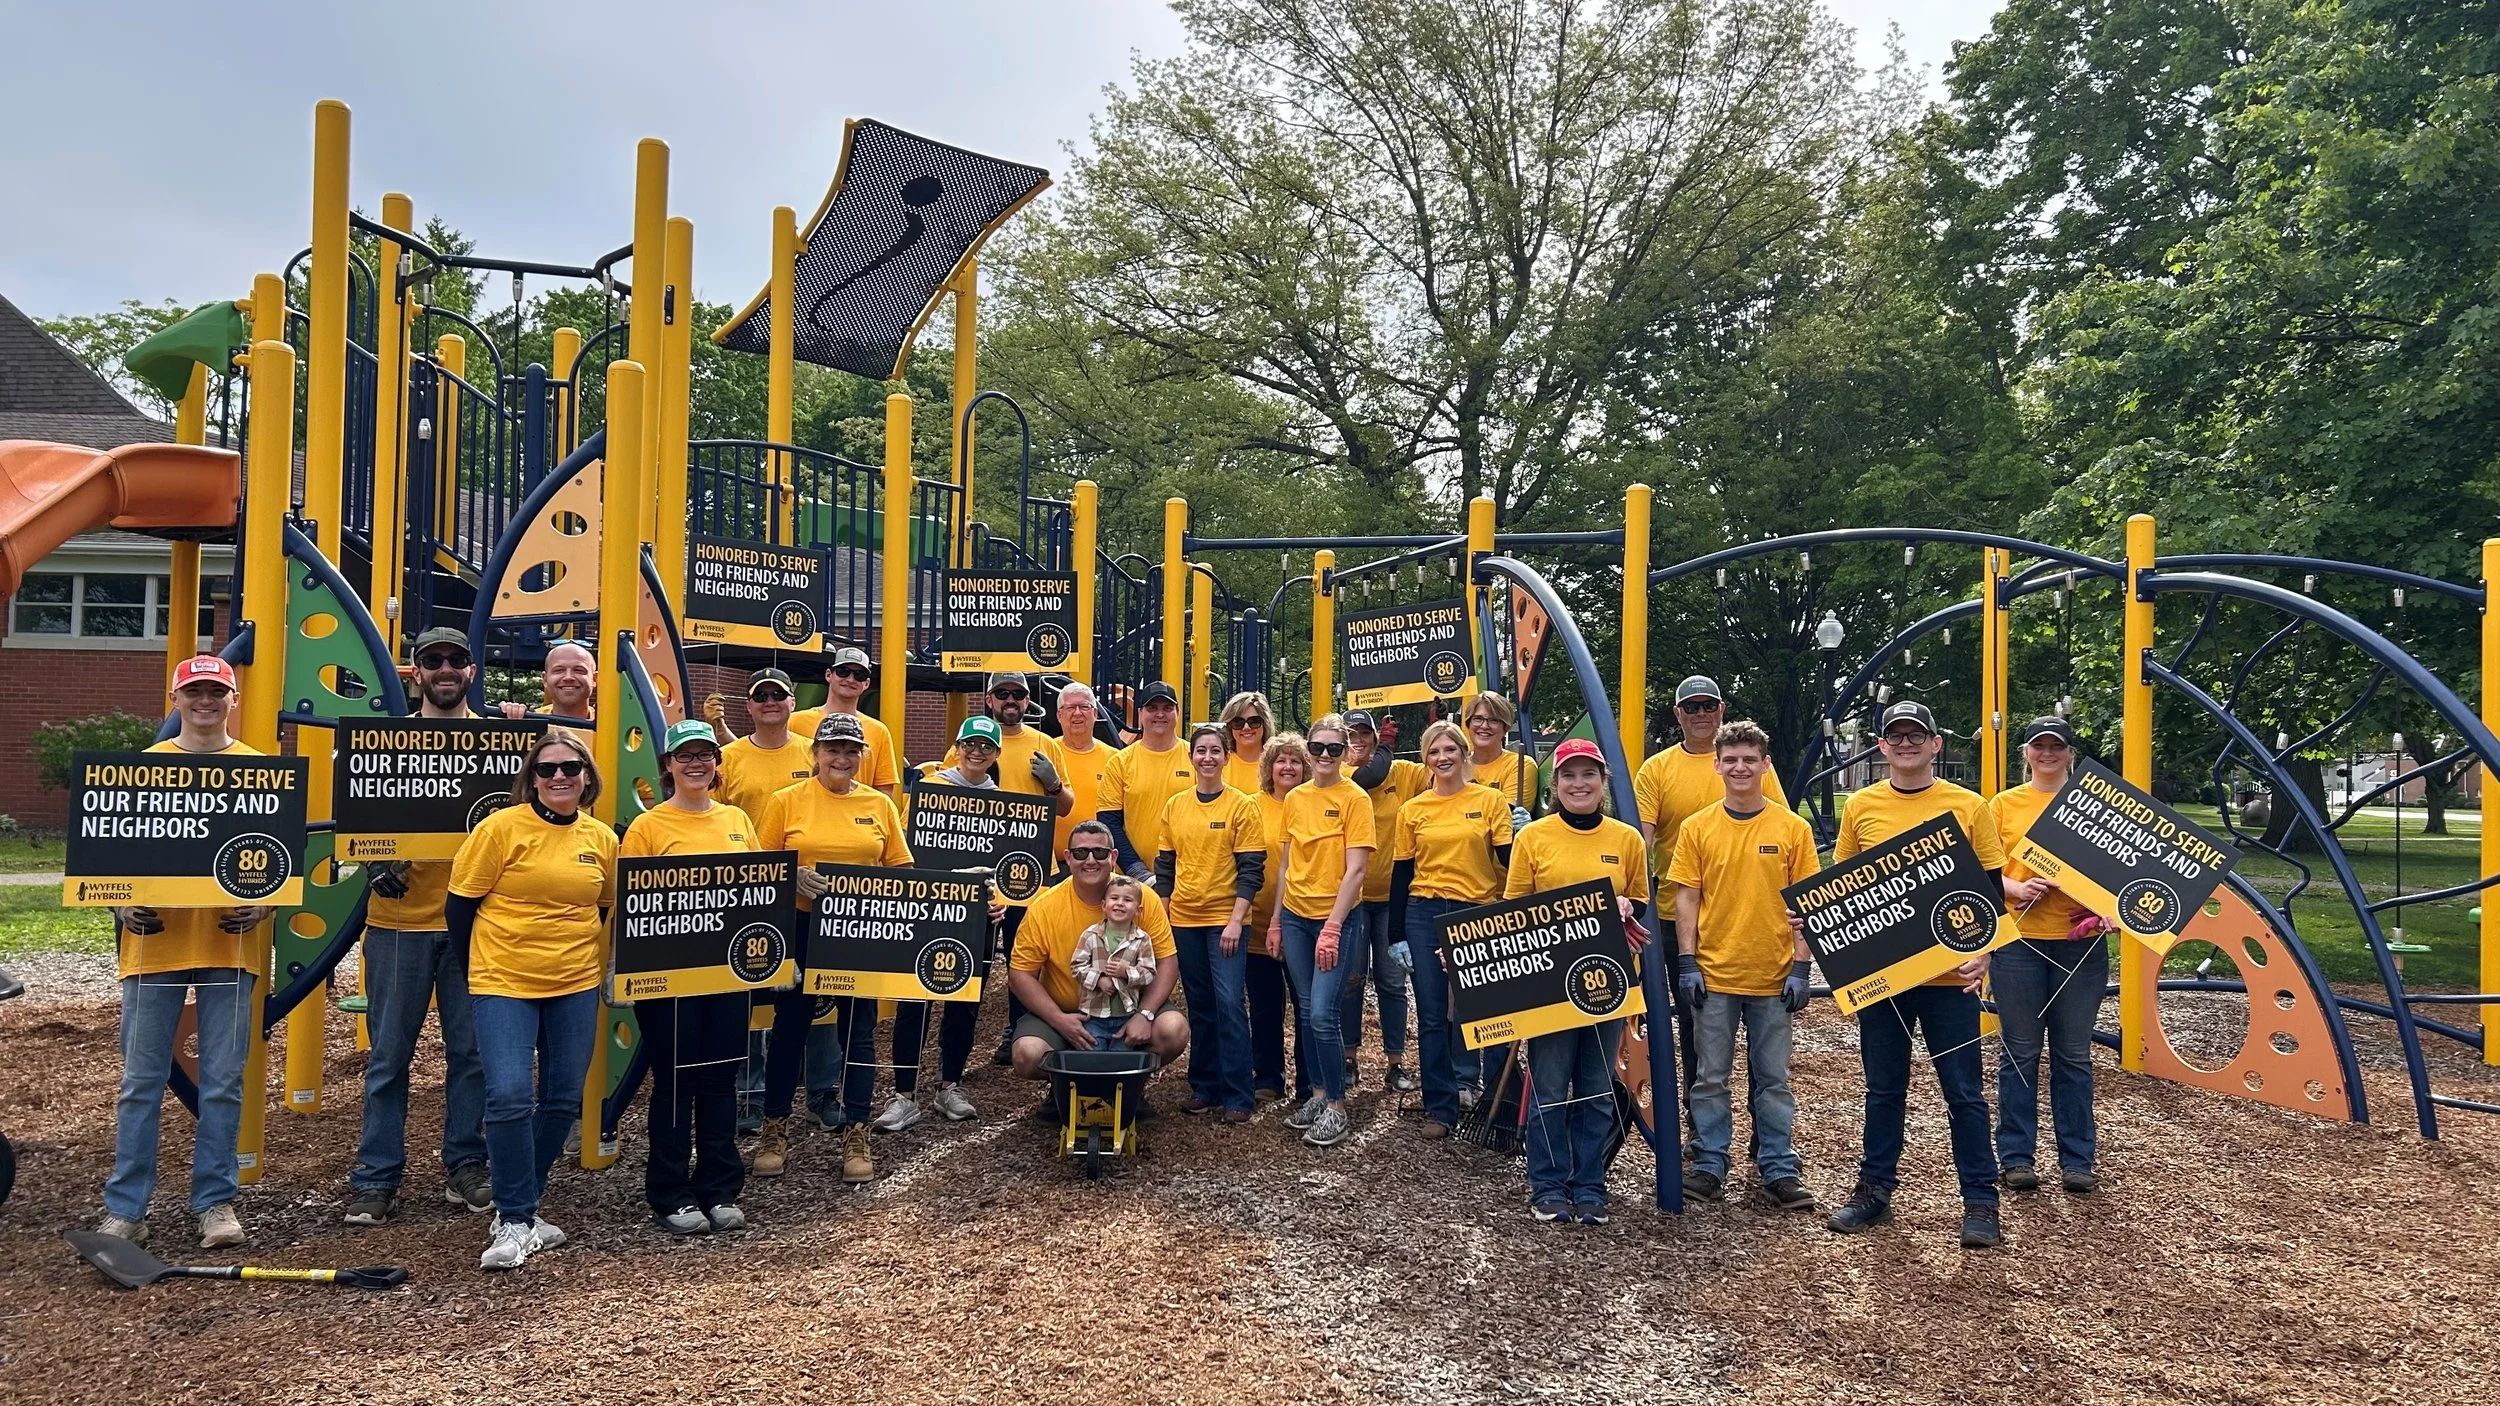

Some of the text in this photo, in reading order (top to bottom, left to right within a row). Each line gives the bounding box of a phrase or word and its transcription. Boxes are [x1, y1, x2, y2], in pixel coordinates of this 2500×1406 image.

[696, 543, 818, 573] HONORED TO SERVE
[695, 561, 809, 589] OUR FRIENDS AND
[949, 577, 1070, 594] HONORED TO SERVE
[695, 578, 769, 601] NEIGHBORS
[949, 594, 1062, 611] OUR FRIENDS AND
[785, 611, 802, 626] 80
[949, 612, 1023, 627] NEIGHBORS
[1347, 607, 1462, 635] HONORED TO SERVE
[1040, 634, 1057, 648] 80
[1349, 624, 1455, 651] OUR FRIENDS AND
[1350, 645, 1419, 667] NEIGHBORS
[1437, 661, 1454, 676] 80
[351, 729, 536, 751] HONORED TO SERVE
[349, 753, 523, 774] OUR FRIENDS AND
[85, 765, 295, 790] HONORED TO SERVE
[349, 777, 462, 798] NEIGHBORS
[82, 790, 279, 814] OUR FRIENDS AND
[918, 792, 1048, 822] HONORED TO SERVE
[81, 816, 209, 839] NEIGHBORS
[916, 811, 1038, 839] OUR FRIENDS AND
[2079, 771, 2226, 871] HONORED TO SERVE
[358, 839, 396, 847] WYFFELS
[914, 830, 994, 853] NEIGHBORS
[2052, 804, 2142, 867] NEIGHBORS
[2067, 789, 2201, 879] OUR FRIENDS AND
[238, 849, 268, 870] 80
[1795, 827, 1957, 914] HONORED TO SERVE
[2028, 857, 2057, 878] HYBRIDS
[2033, 851, 2061, 872] WYFFELS
[627, 862, 787, 890] HONORED TO SERVE
[1010, 863, 1028, 880] 80
[88, 892, 132, 900] HYBRIDS
[89, 883, 132, 891] WYFFELS
[825, 874, 979, 902] HONORED TO SERVE
[1807, 854, 1955, 934] OUR FRIENDS AND
[626, 886, 776, 914] OUR FRIENDS AND
[821, 896, 967, 923] OUR FRIENDS AND
[2138, 891, 2165, 914] 80
[626, 911, 724, 938] NEIGHBORS
[1446, 891, 1607, 945] HONORED TO SERVE
[1817, 897, 1915, 955] NEIGHBORS
[1948, 904, 1975, 929] 80
[1956, 921, 1980, 935] WYFFELS
[819, 918, 914, 941] NEIGHBORS
[746, 937, 768, 957] 80
[1452, 917, 1600, 966] OUR FRIENDS AND
[934, 951, 956, 970] 80
[1457, 950, 1554, 989] NEIGHBORS
[633, 976, 667, 986] WYFFELS
[633, 985, 667, 994] HYBRIDS
[822, 983, 854, 991] HYBRIDS
[823, 975, 855, 983] WYFFELS
[1583, 968, 1607, 991] 80
[1853, 976, 1886, 995] WYFFELS
[1857, 983, 1890, 1003] HYBRIDS
[1480, 1020, 1513, 1033] WYFFELS
[1482, 1028, 1515, 1041] HYBRIDS
